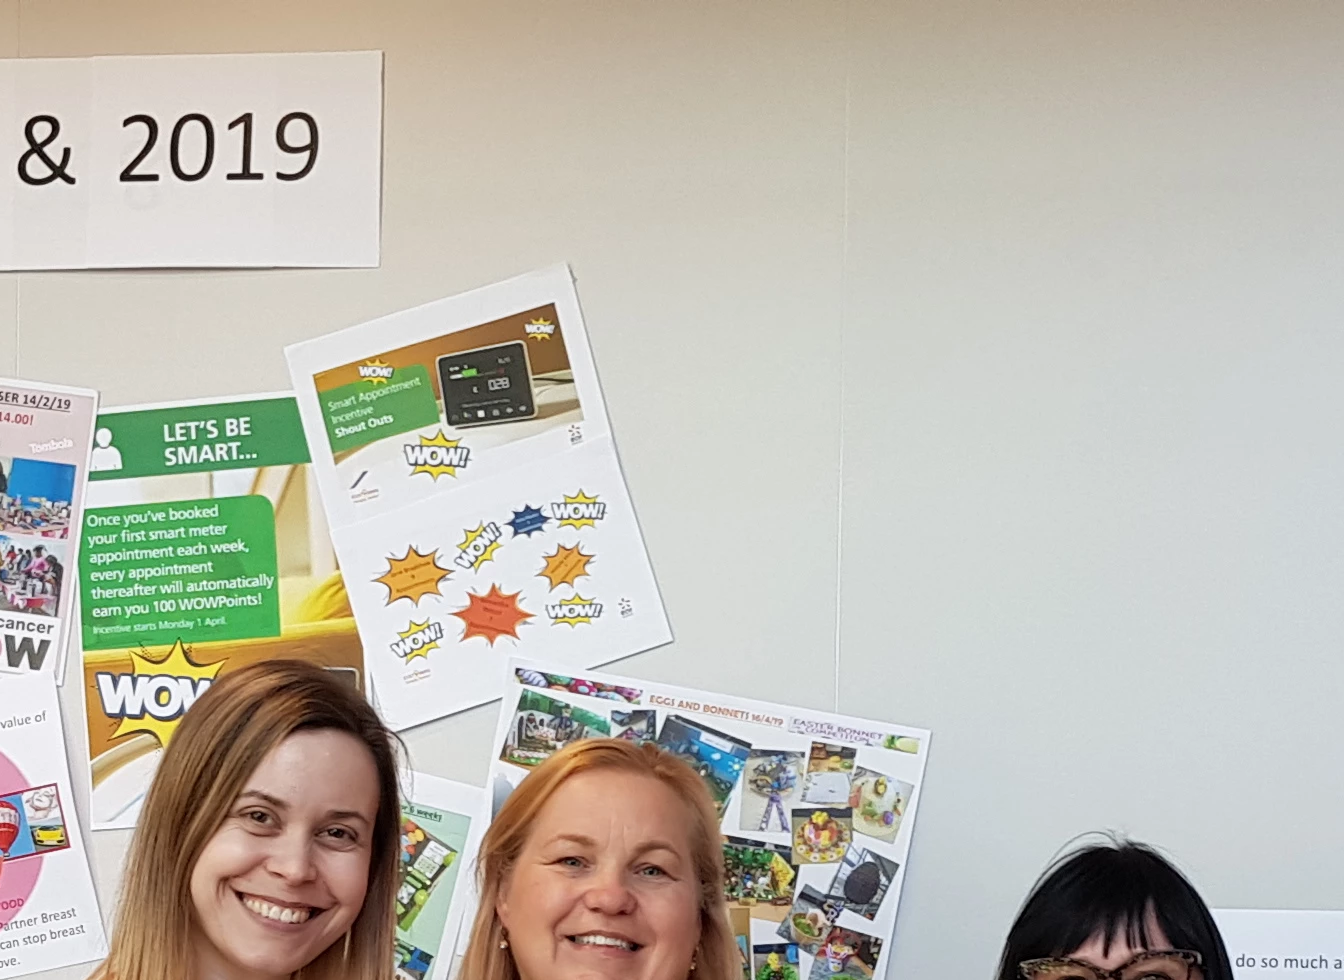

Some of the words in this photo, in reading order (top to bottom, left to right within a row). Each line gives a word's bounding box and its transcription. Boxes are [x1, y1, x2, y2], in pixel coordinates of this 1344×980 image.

[17, 114, 75, 185] &
[119, 111, 318, 182] 2019
[22, 394, 70, 409] 14/2/19
[328, 396, 356, 411] Smart
[359, 377, 422, 403] Appointment
[224, 416, 251, 436] BE
[334, 422, 366, 438] Shout
[368, 414, 393, 428] Outs
[164, 441, 257, 466] SMART...
[404, 445, 469, 468] WOW!
[87, 515, 120, 527] Once
[168, 503, 218, 520] booked
[551, 502, 606, 520] WOW!
[87, 533, 118, 548] your
[119, 529, 146, 542] first
[148, 526, 186, 540] smart
[188, 524, 227, 537] meter
[89, 545, 174, 565] appointment
[176, 541, 207, 556] each
[209, 538, 249, 553] week,
[90, 569, 125, 582] every
[127, 561, 213, 581] appointment
[91, 583, 157, 600] thereafter
[159, 580, 183, 594] will
[186, 574, 274, 593] automatically
[91, 606, 121, 617] earn
[123, 604, 149, 618] you
[153, 599, 176, 612] 100
[177, 592, 262, 610] WOWPoints!
[1235, 953, 1255, 967] do
[1260, 957, 1278, 968] so
[1284, 954, 1328, 969] much
